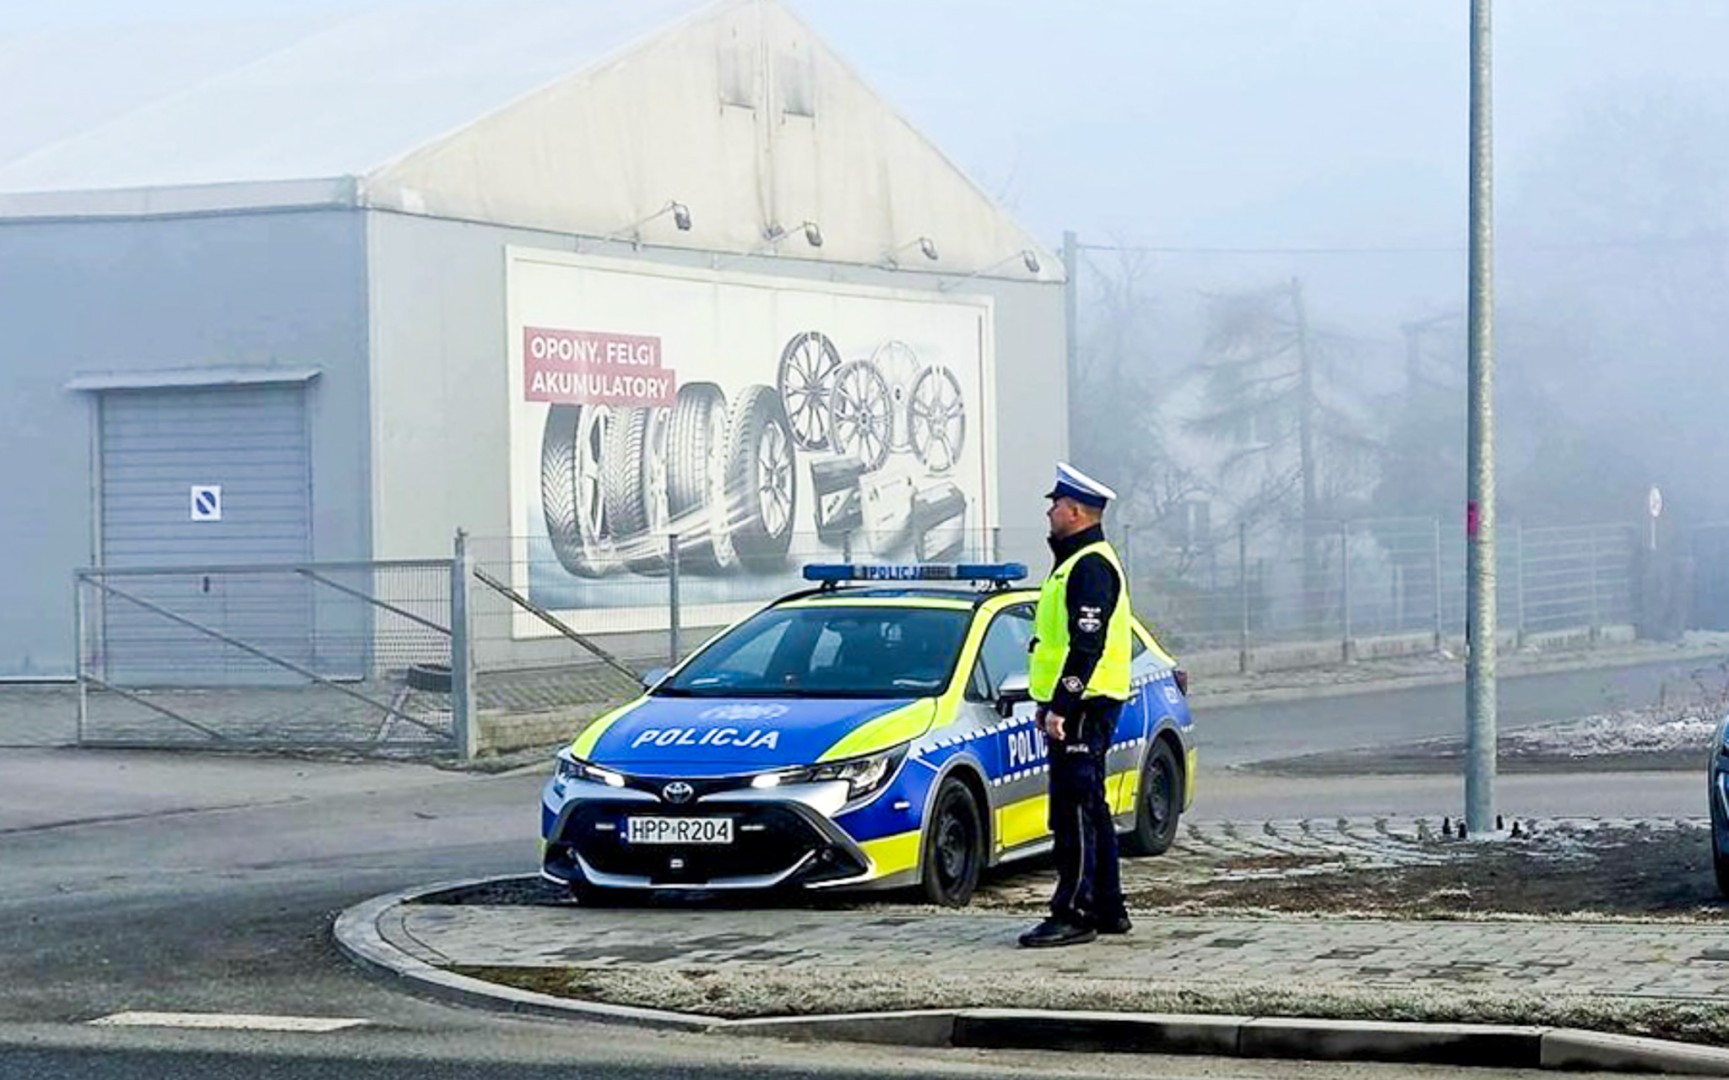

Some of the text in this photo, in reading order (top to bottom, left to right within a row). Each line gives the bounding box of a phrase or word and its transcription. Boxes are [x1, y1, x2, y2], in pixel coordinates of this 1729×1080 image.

[607, 342, 654, 367] FELGI
[531, 370, 668, 399] AKUMULATORY
[631, 728, 780, 749] POLICJA
[1008, 727, 1049, 768] POLIC
[632, 820, 728, 841] HPP R204
